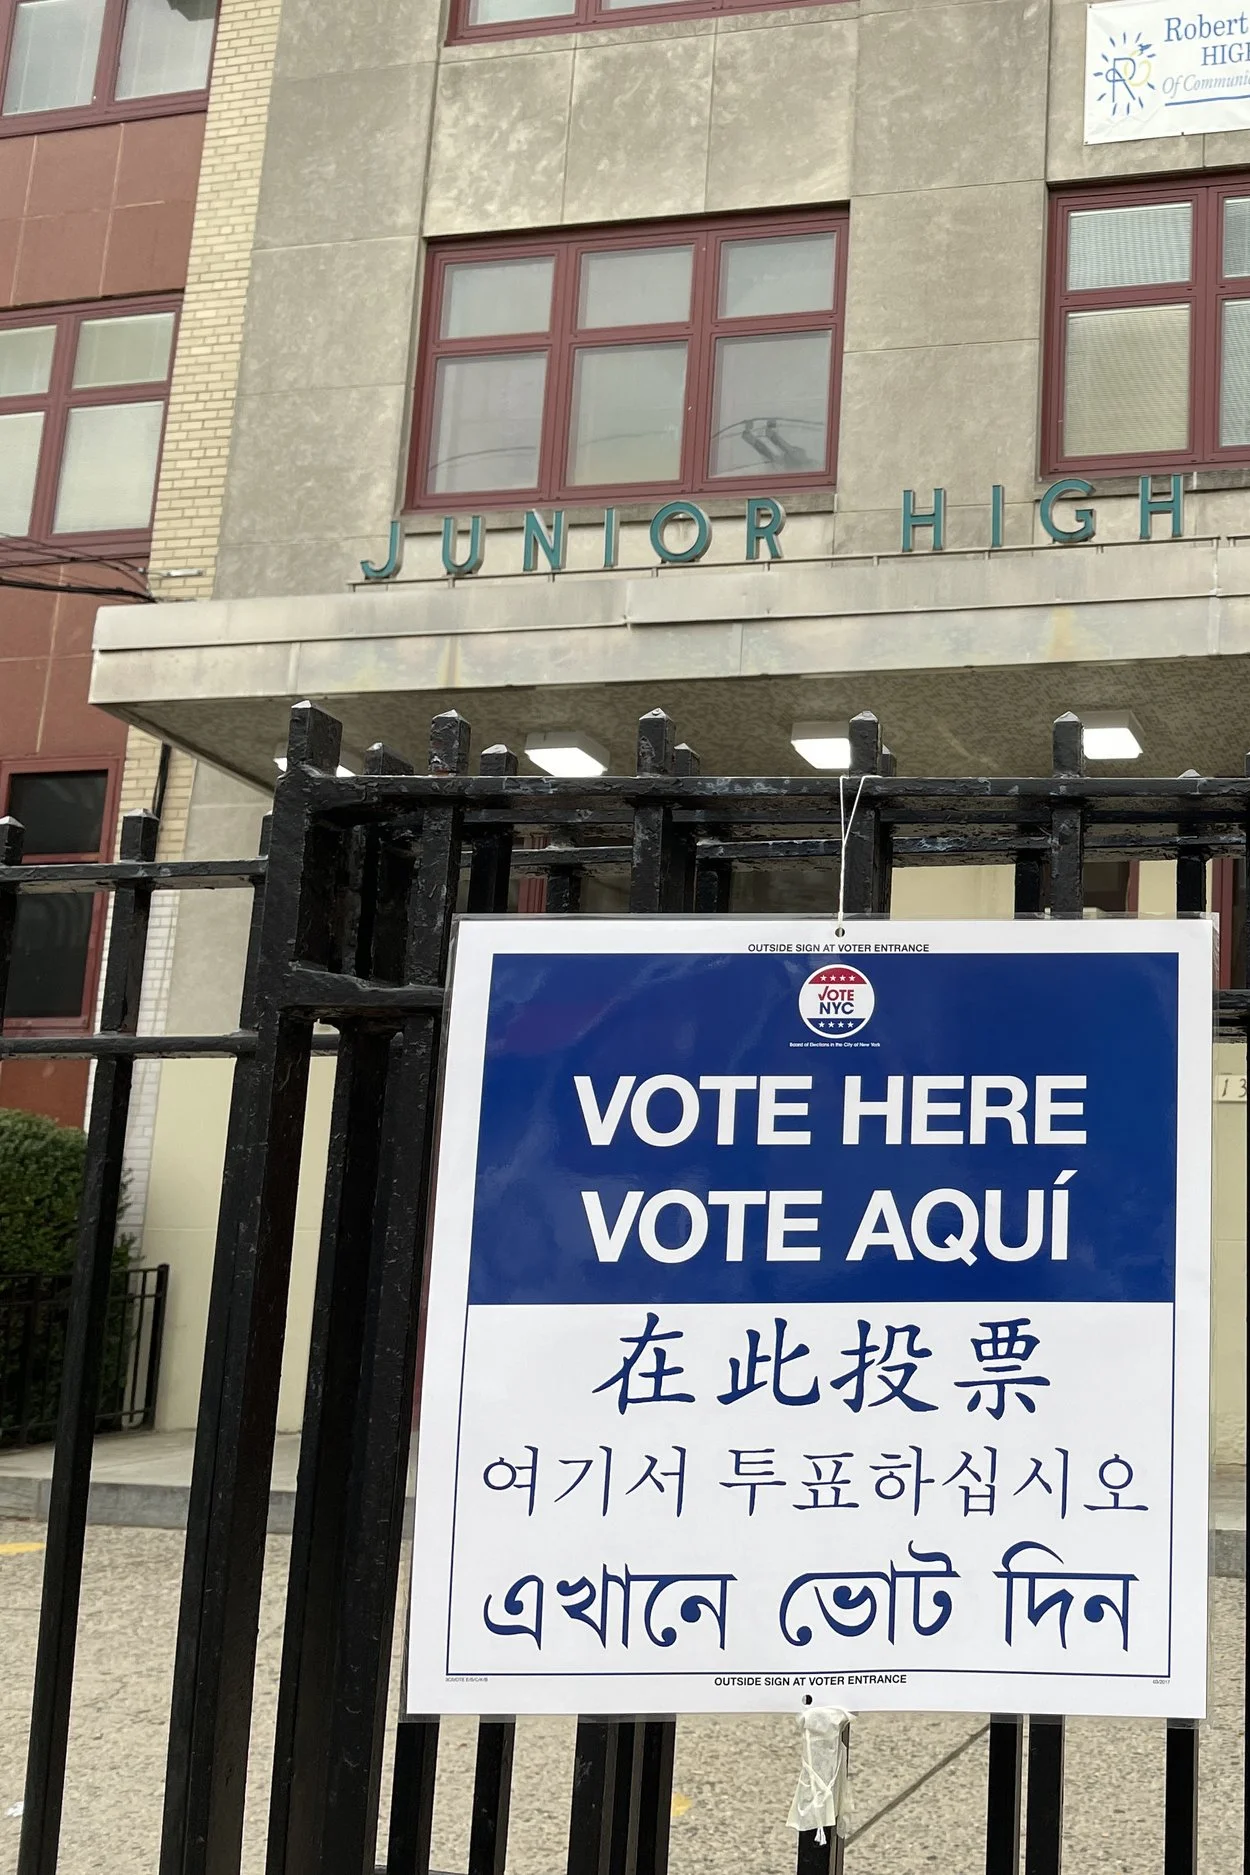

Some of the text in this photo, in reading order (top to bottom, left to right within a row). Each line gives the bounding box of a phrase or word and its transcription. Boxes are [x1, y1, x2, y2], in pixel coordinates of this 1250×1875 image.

[1164, 11, 1249, 42] Robert
[1162, 75, 1183, 99] Of
[360, 497, 787, 580] JUNIOR
[901, 474, 1187, 553] HIGH
[748, 943, 930, 952] OUTSIDE SIGN AT VOTER ENTRANCE
[818, 986, 855, 1001] VOTE
[819, 1002, 855, 1015] NYC
[573, 1073, 1088, 1147] VOTE HERE
[580, 1169, 1078, 1267] VOTE AQUÍ
[592, 1312, 1051, 1420] 在此投票
[482, 1445, 1149, 1519] 여기서 투표하십시오
[483, 1540, 1139, 1652] এখানে ভোট দিন
[714, 1674, 907, 1686] OUTSIDE SIGN AT VOTER ENTRANCE
